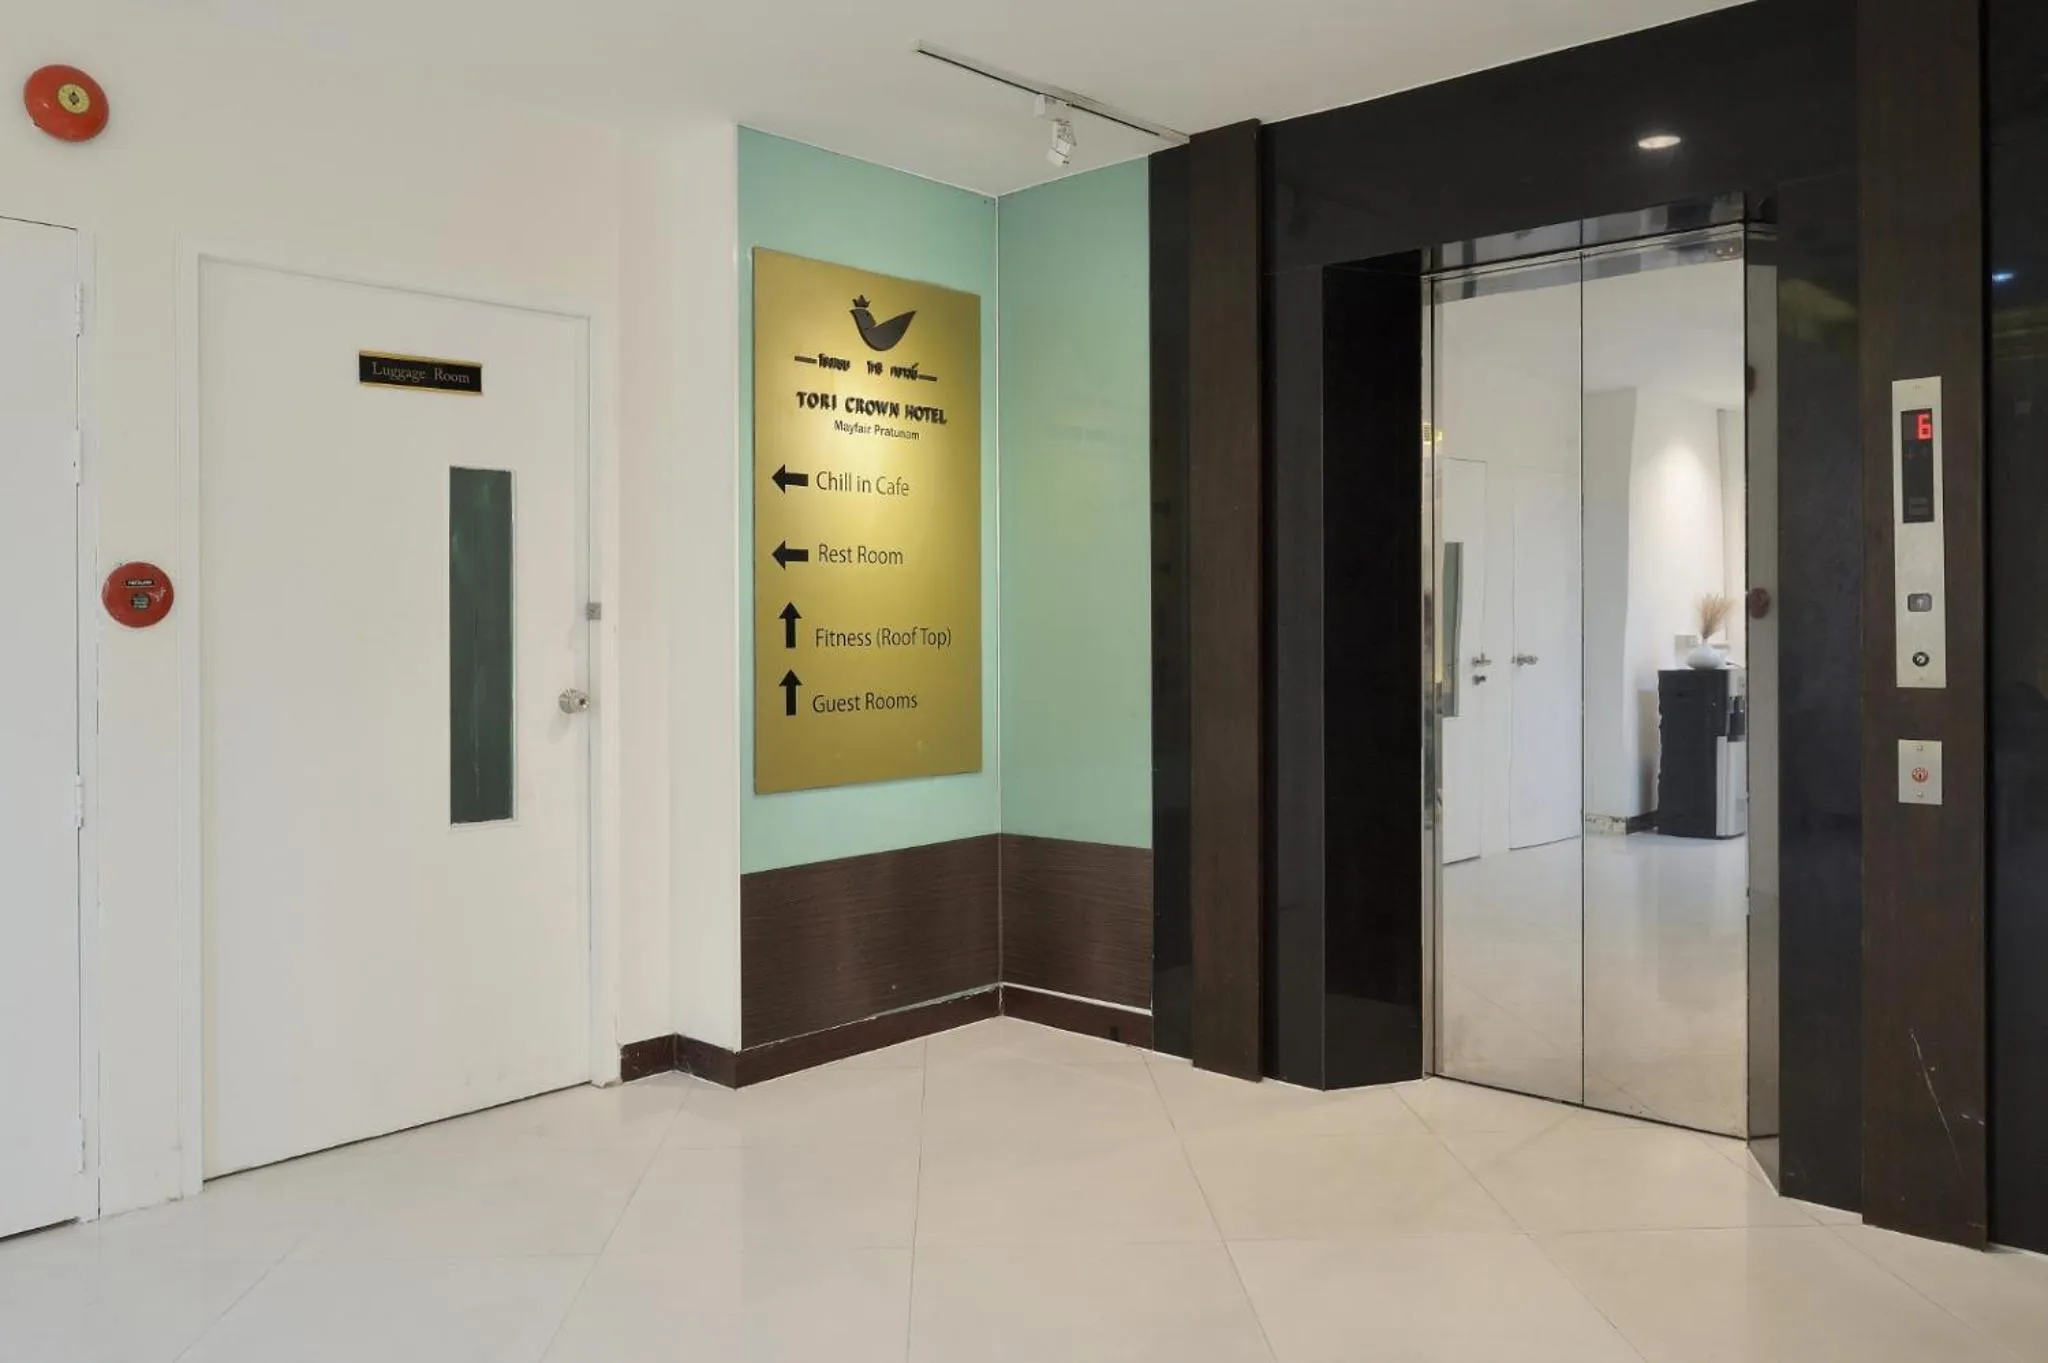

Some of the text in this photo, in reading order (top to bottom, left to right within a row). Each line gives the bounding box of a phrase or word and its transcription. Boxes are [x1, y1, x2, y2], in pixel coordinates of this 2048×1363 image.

[372, 361, 471, 384] Luggage Room
[796, 391, 947, 425] TORI CROWN HOTEL
[834, 420, 920, 440] Mayfair Pratunam
[1917, 413, 1932, 440] 6
[816, 470, 910, 496] Chill in Cafe
[818, 543, 904, 565] Rest Room
[815, 625, 952, 650] Fitness (Roof Top)
[812, 691, 918, 714] Guest Rooms
